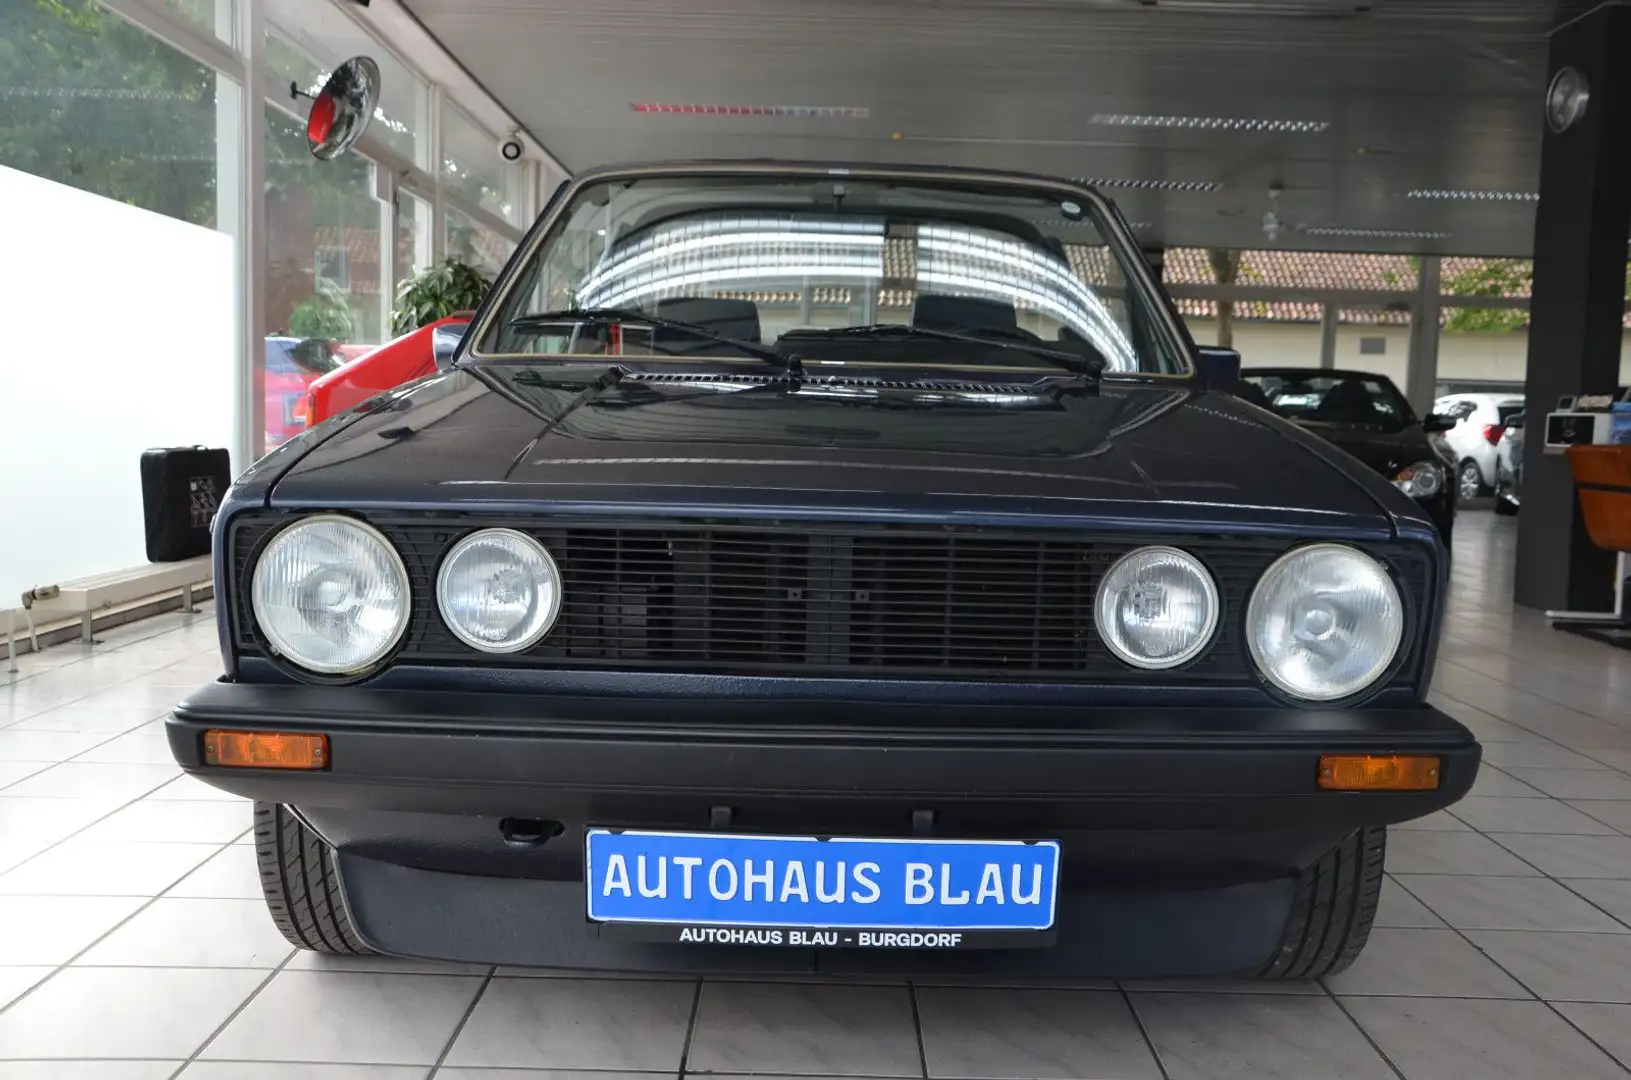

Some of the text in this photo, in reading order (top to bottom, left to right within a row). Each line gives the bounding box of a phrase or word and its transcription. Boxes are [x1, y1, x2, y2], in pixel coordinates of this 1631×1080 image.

[602, 853, 1043, 906] AUTOHAUS BLAU
[679, 927, 783, 945] AUTOHAUS
[789, 930, 838, 946] BLAU
[858, 932, 963, 948] BURGDORF
